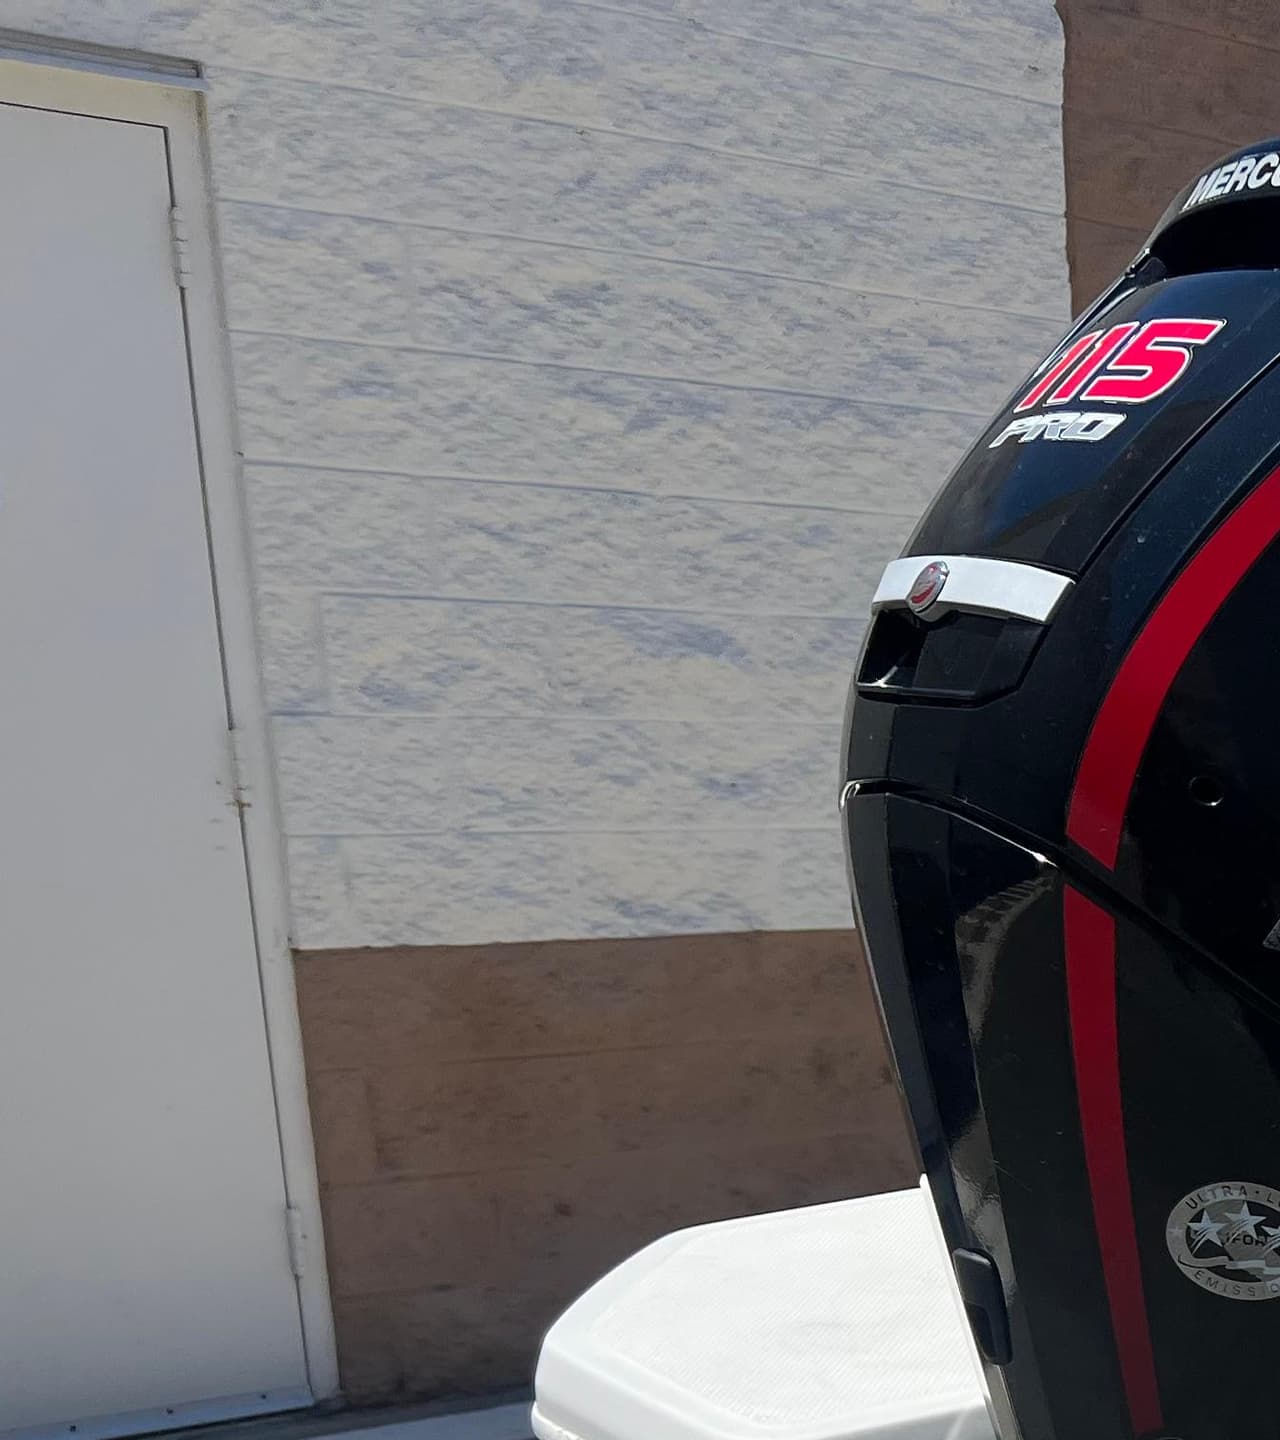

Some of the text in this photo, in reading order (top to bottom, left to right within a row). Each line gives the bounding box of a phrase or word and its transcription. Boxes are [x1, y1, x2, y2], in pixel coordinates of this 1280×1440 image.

[1012, 318, 1228, 413] 115
[989, 411, 1127, 448] PRO
[1184, 1185, 1248, 1210] ULTRA
